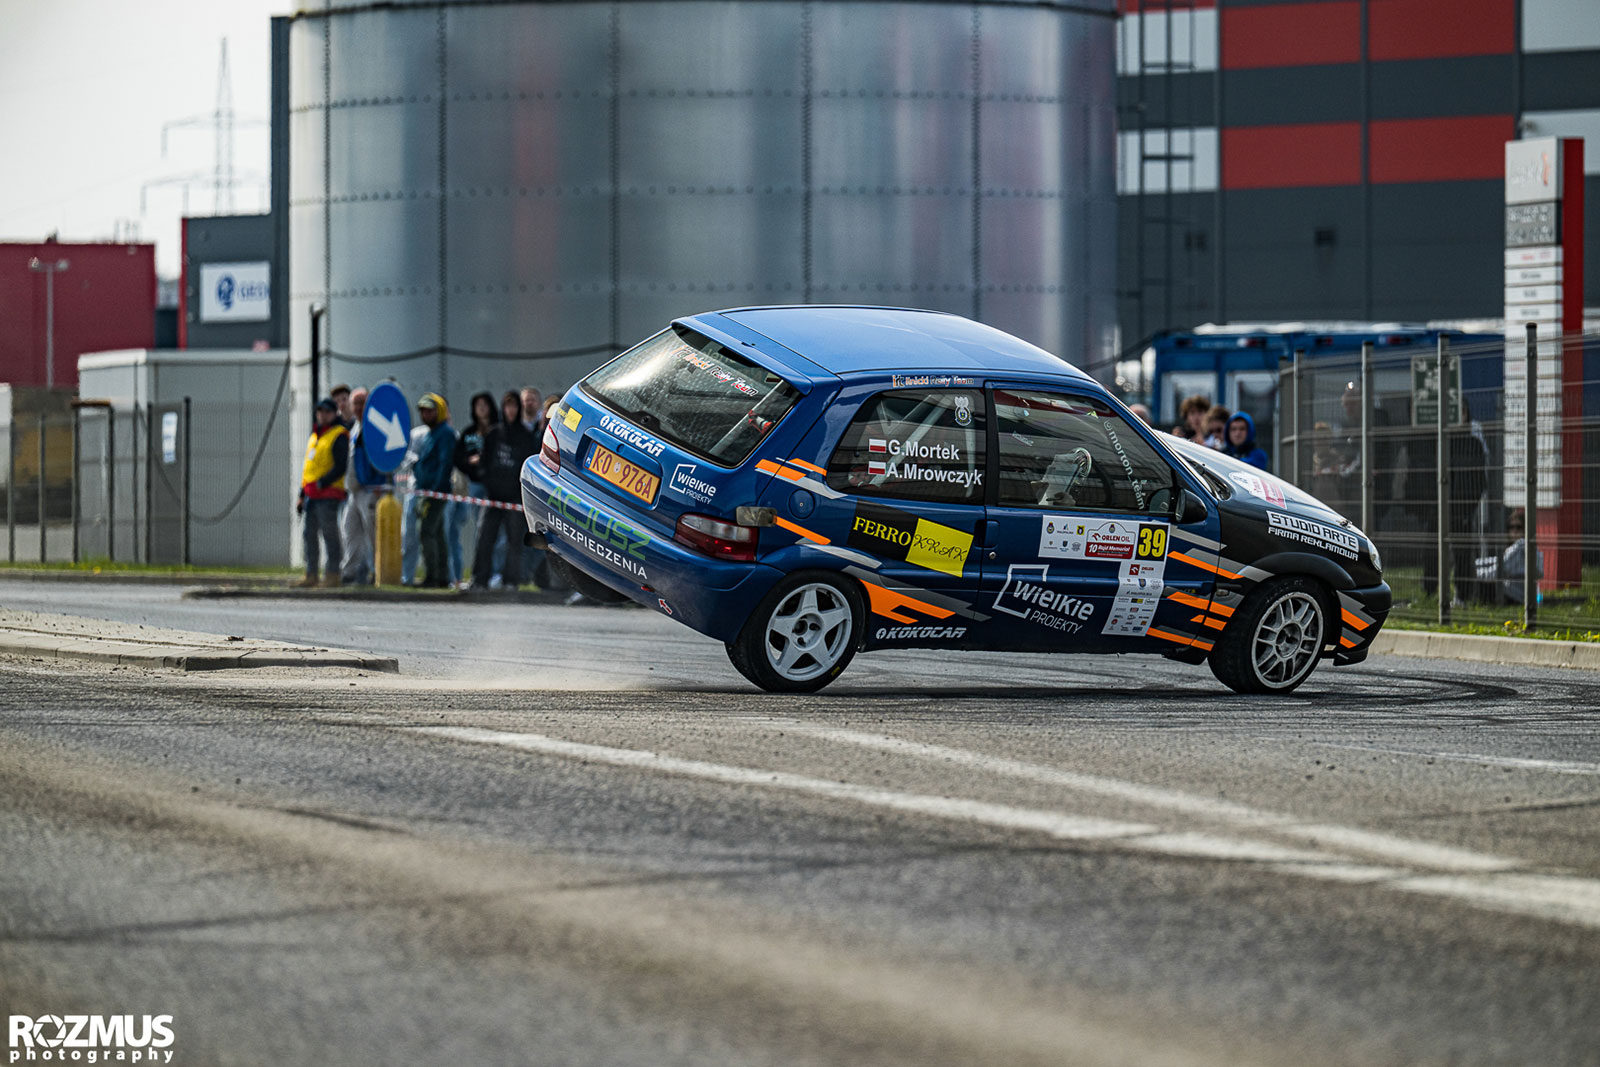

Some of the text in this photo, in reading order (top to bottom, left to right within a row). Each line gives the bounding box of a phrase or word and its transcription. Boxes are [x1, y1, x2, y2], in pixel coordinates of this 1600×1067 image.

[606, 419, 666, 457] KOKOCAR
[888, 439, 960, 461] G.Mortek
[619, 464, 653, 499] 976A
[886, 462, 982, 488] A.Mrowczyk
[853, 516, 912, 547] FERRO
[1138, 527, 1167, 558] 39
[1268, 527, 1359, 561] FIRMA REKLAMOWA
[1270, 512, 1359, 548] STUDIO ARTE
[547, 512, 648, 580] UBEZPIECZENIA
[1088, 543, 1098, 553] 10
[885, 626, 967, 639] KOKOCAR
[1030, 610, 1083, 635] PROJEKTY
